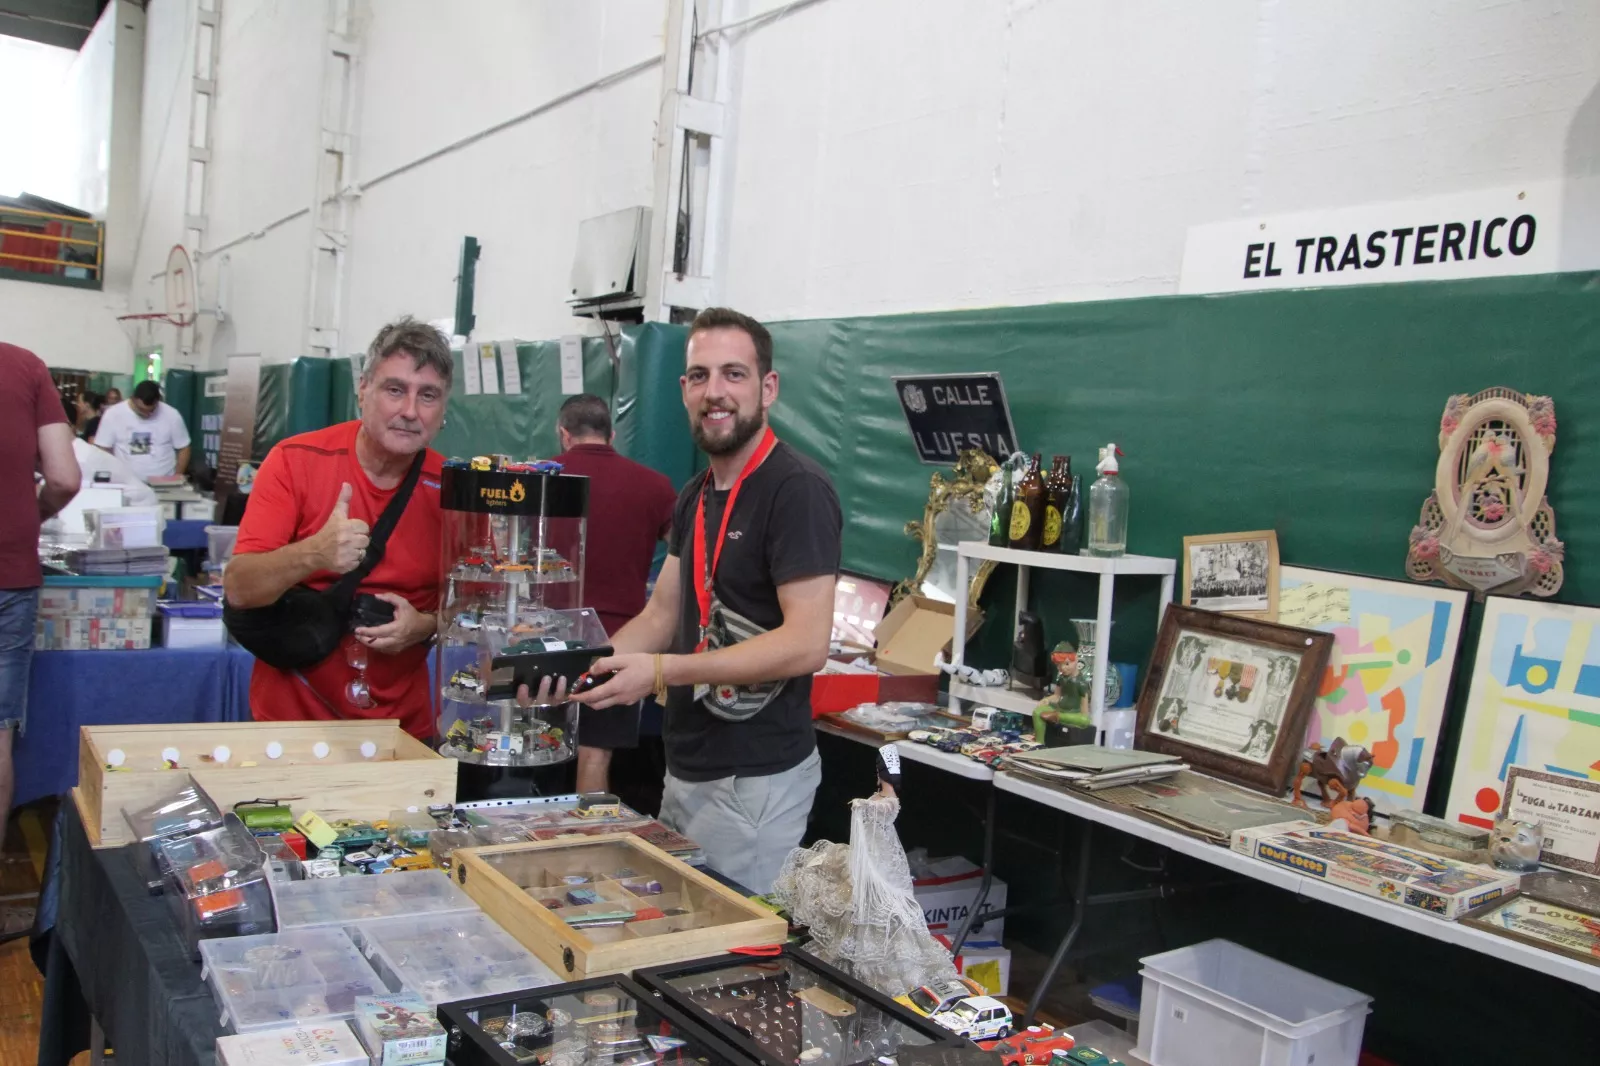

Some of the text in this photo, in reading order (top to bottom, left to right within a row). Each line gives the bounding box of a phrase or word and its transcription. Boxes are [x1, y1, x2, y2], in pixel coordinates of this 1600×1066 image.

[1243, 213, 1537, 279] EL TRASTERICO
[932, 385, 992, 406] CALLE
[480, 487, 508, 499] FUEL
[1522, 795, 1545, 808] FUGA
[1557, 803, 1600, 820] TARZAN
[923, 903, 992, 923] KINTAT
